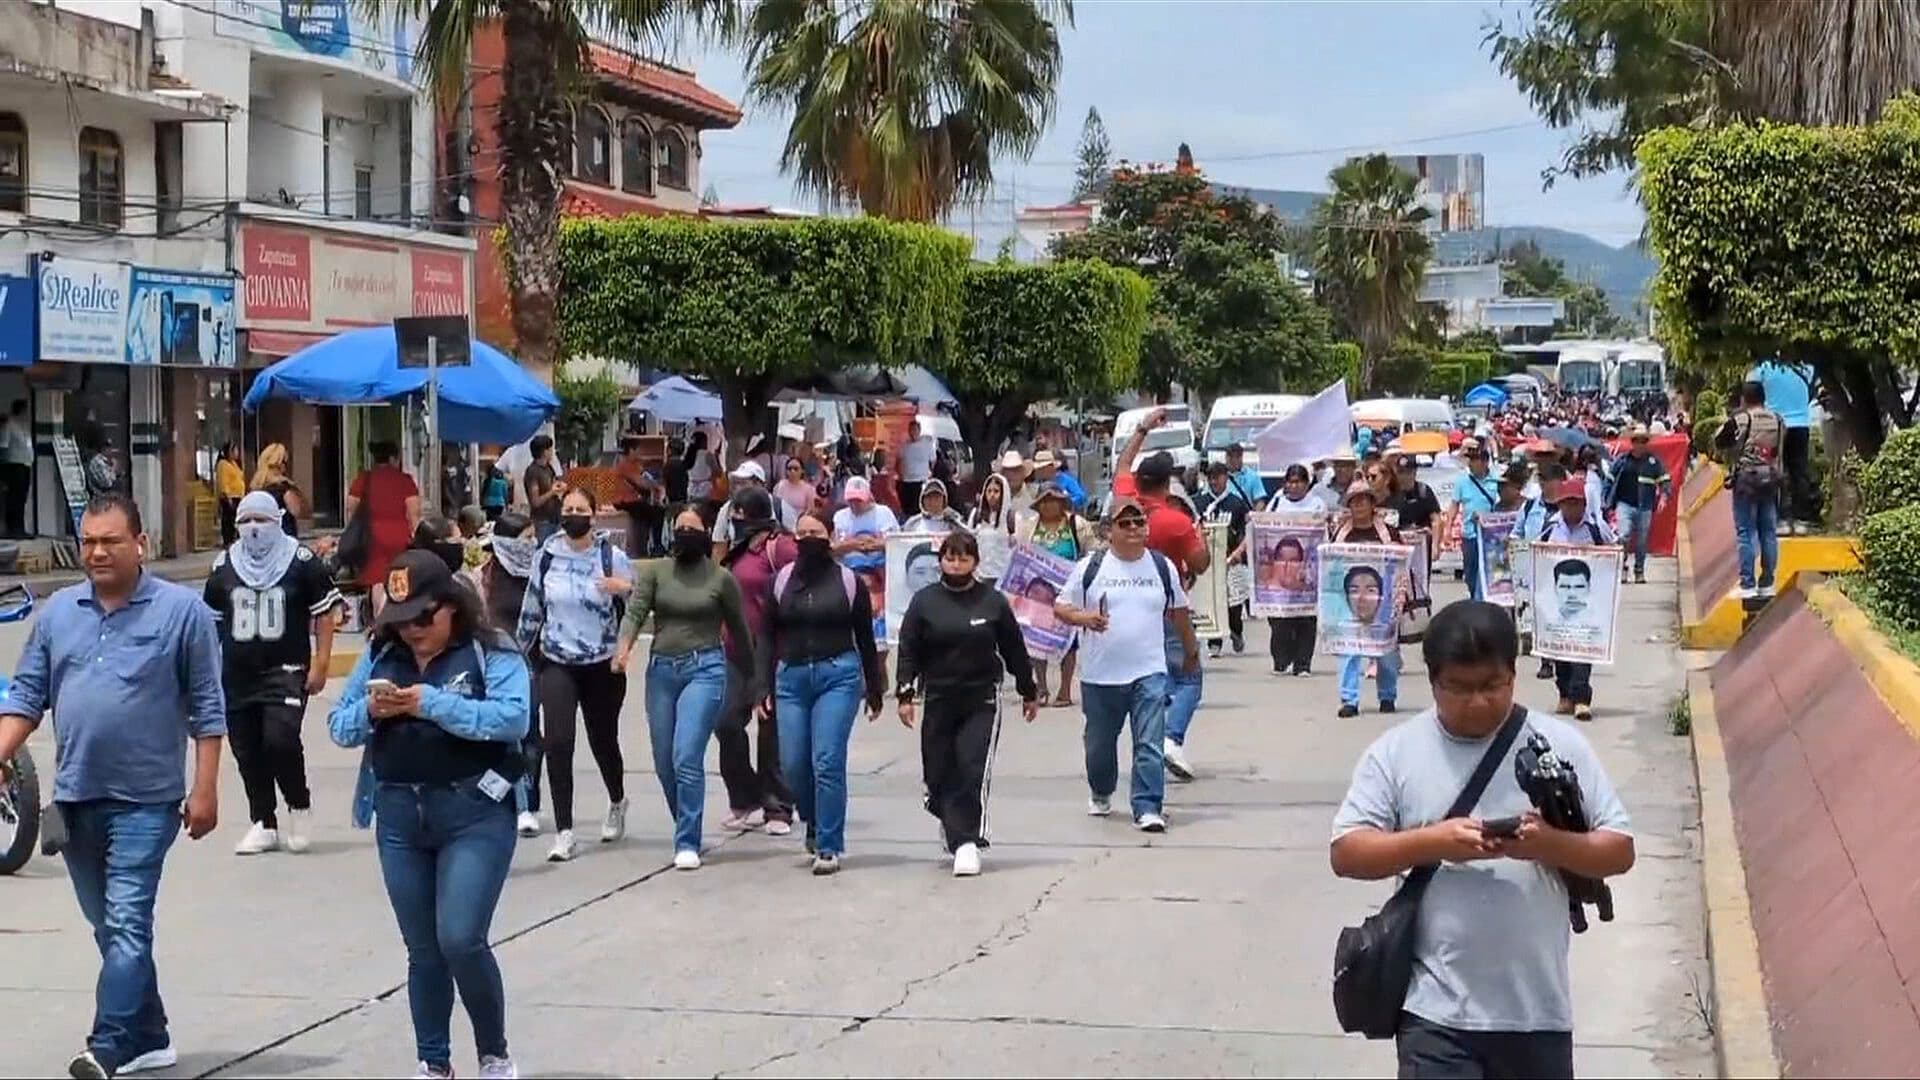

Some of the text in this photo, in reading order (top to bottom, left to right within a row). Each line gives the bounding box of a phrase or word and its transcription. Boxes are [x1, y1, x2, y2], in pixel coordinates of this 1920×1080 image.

[60, 273, 119, 320] Realice
[246, 274, 309, 312] GIOVANNA
[230, 586, 287, 641] 60
